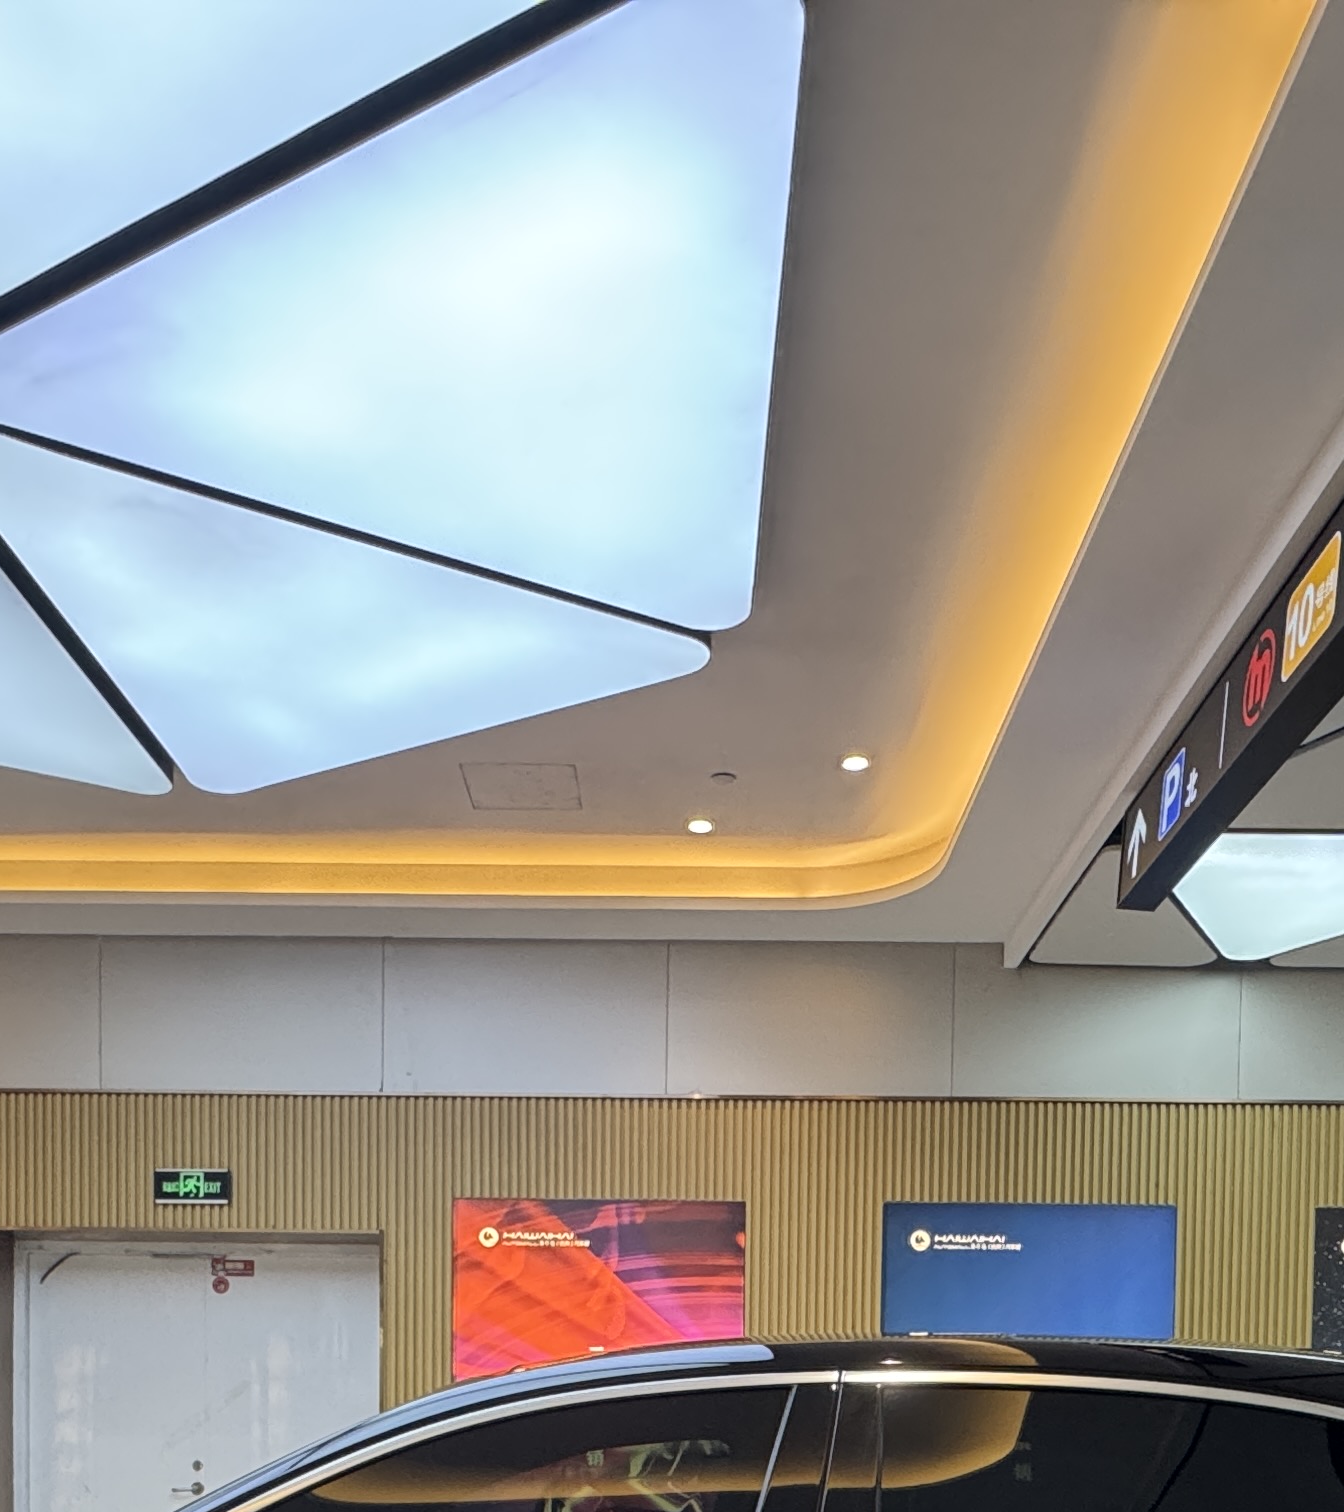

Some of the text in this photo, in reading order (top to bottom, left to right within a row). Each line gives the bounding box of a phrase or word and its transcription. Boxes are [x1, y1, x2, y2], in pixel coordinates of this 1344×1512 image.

[1285, 582, 1314, 661] 10
[1161, 762, 1181, 833] P
[204, 1181, 222, 1194] EXIT
